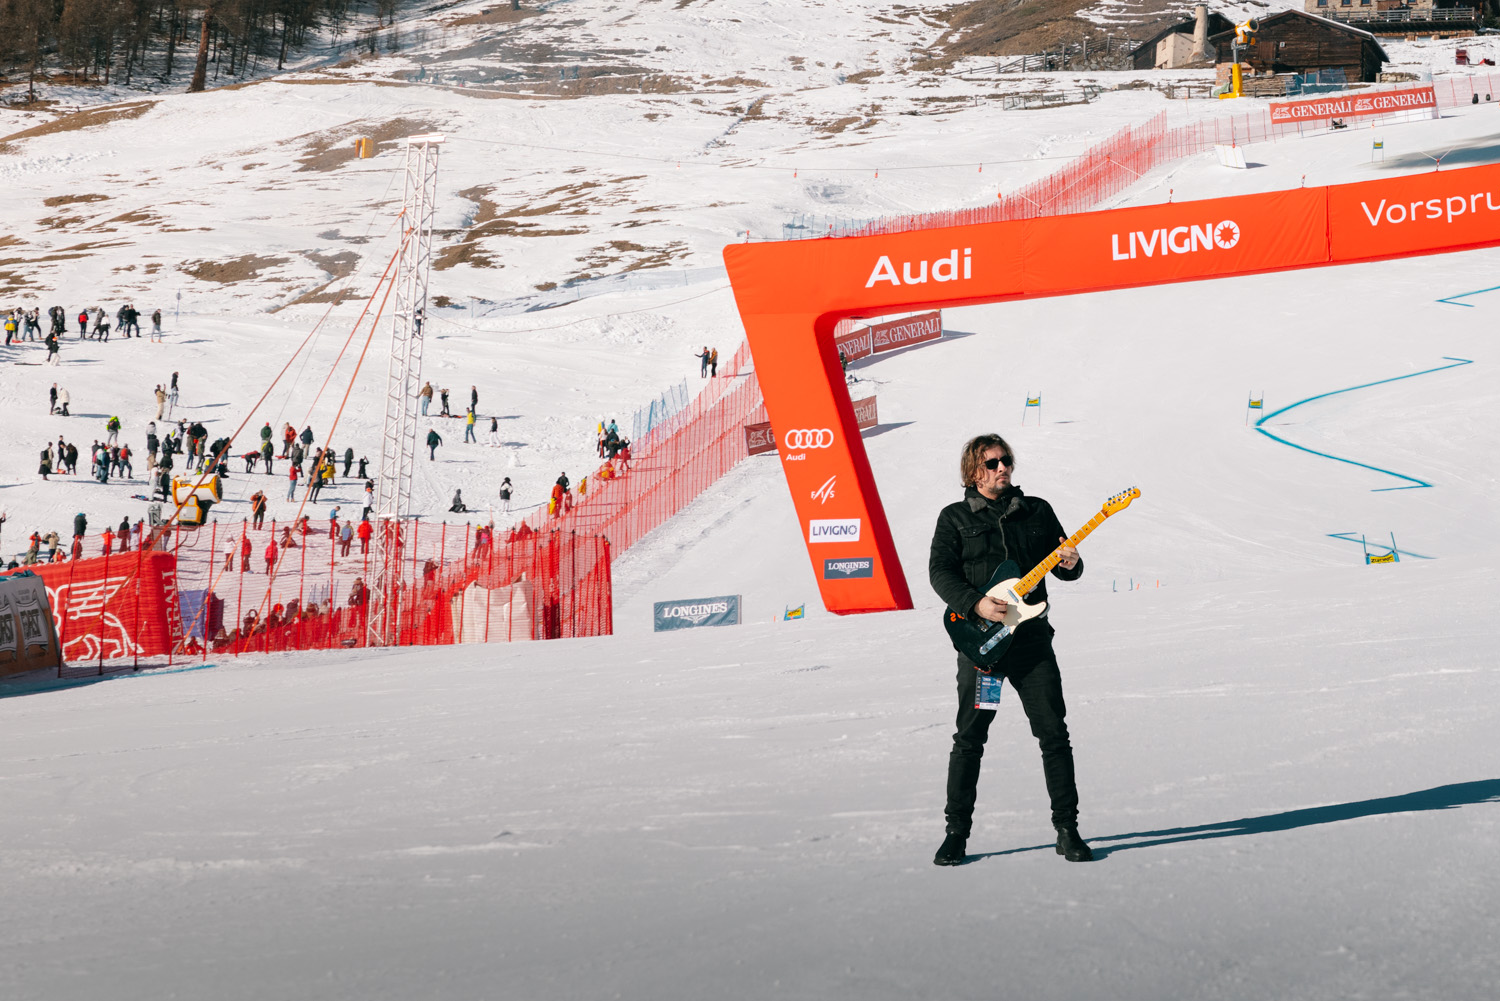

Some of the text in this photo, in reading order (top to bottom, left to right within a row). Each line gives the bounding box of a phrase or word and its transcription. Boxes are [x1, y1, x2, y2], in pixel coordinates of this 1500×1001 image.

[1291, 100, 1352, 118] GENERALI
[1373, 91, 1434, 109] GENERALI
[1111, 219, 1241, 262] LIVIGNO
[864, 247, 972, 289] Audi
[889, 317, 941, 344] GENERALI
[836, 333, 871, 356] ENERALI
[785, 453, 806, 461] Audi
[812, 525, 858, 536] LIVIGNO
[828, 561, 870, 571] LONGINES
[663, 602, 728, 619] LONGINES
